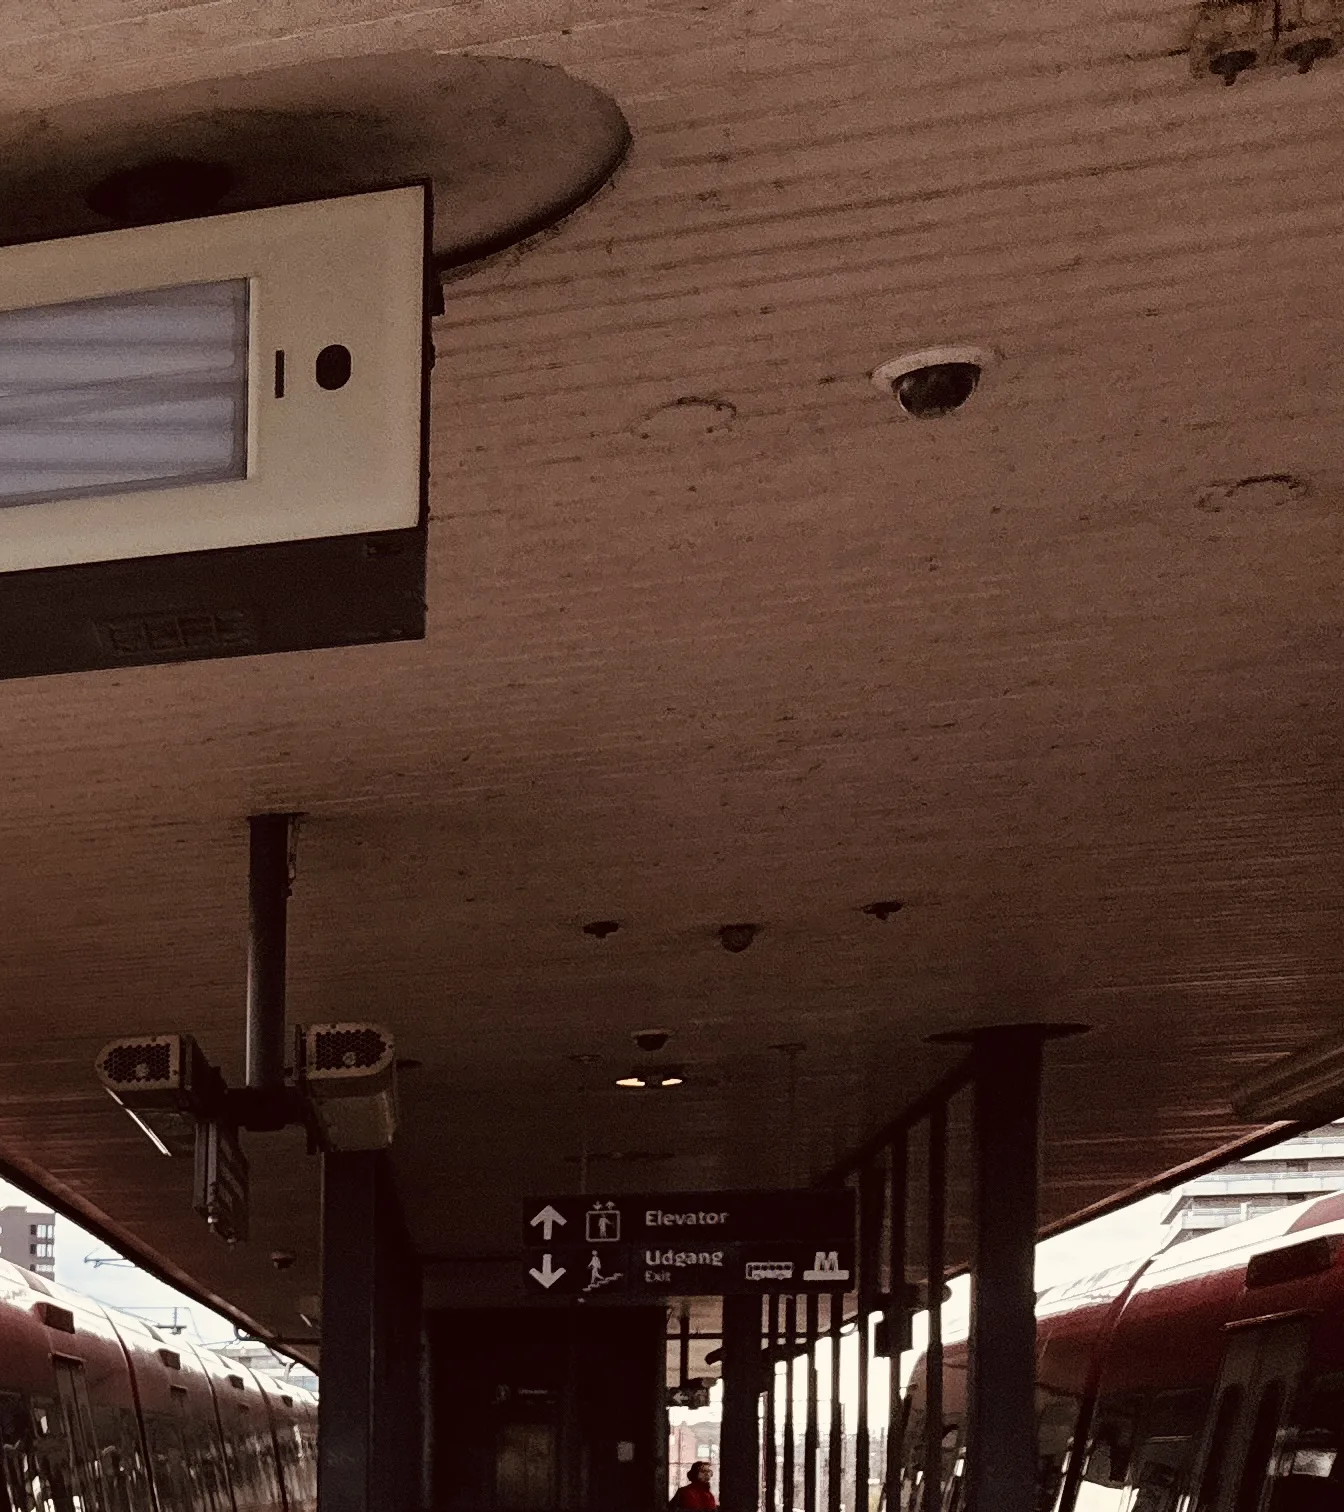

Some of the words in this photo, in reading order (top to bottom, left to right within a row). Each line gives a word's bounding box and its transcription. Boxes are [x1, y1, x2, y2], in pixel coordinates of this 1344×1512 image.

[645, 1210, 728, 1227] Elevator
[645, 1250, 725, 1268] Udgang
[645, 1271, 671, 1283] Exit
